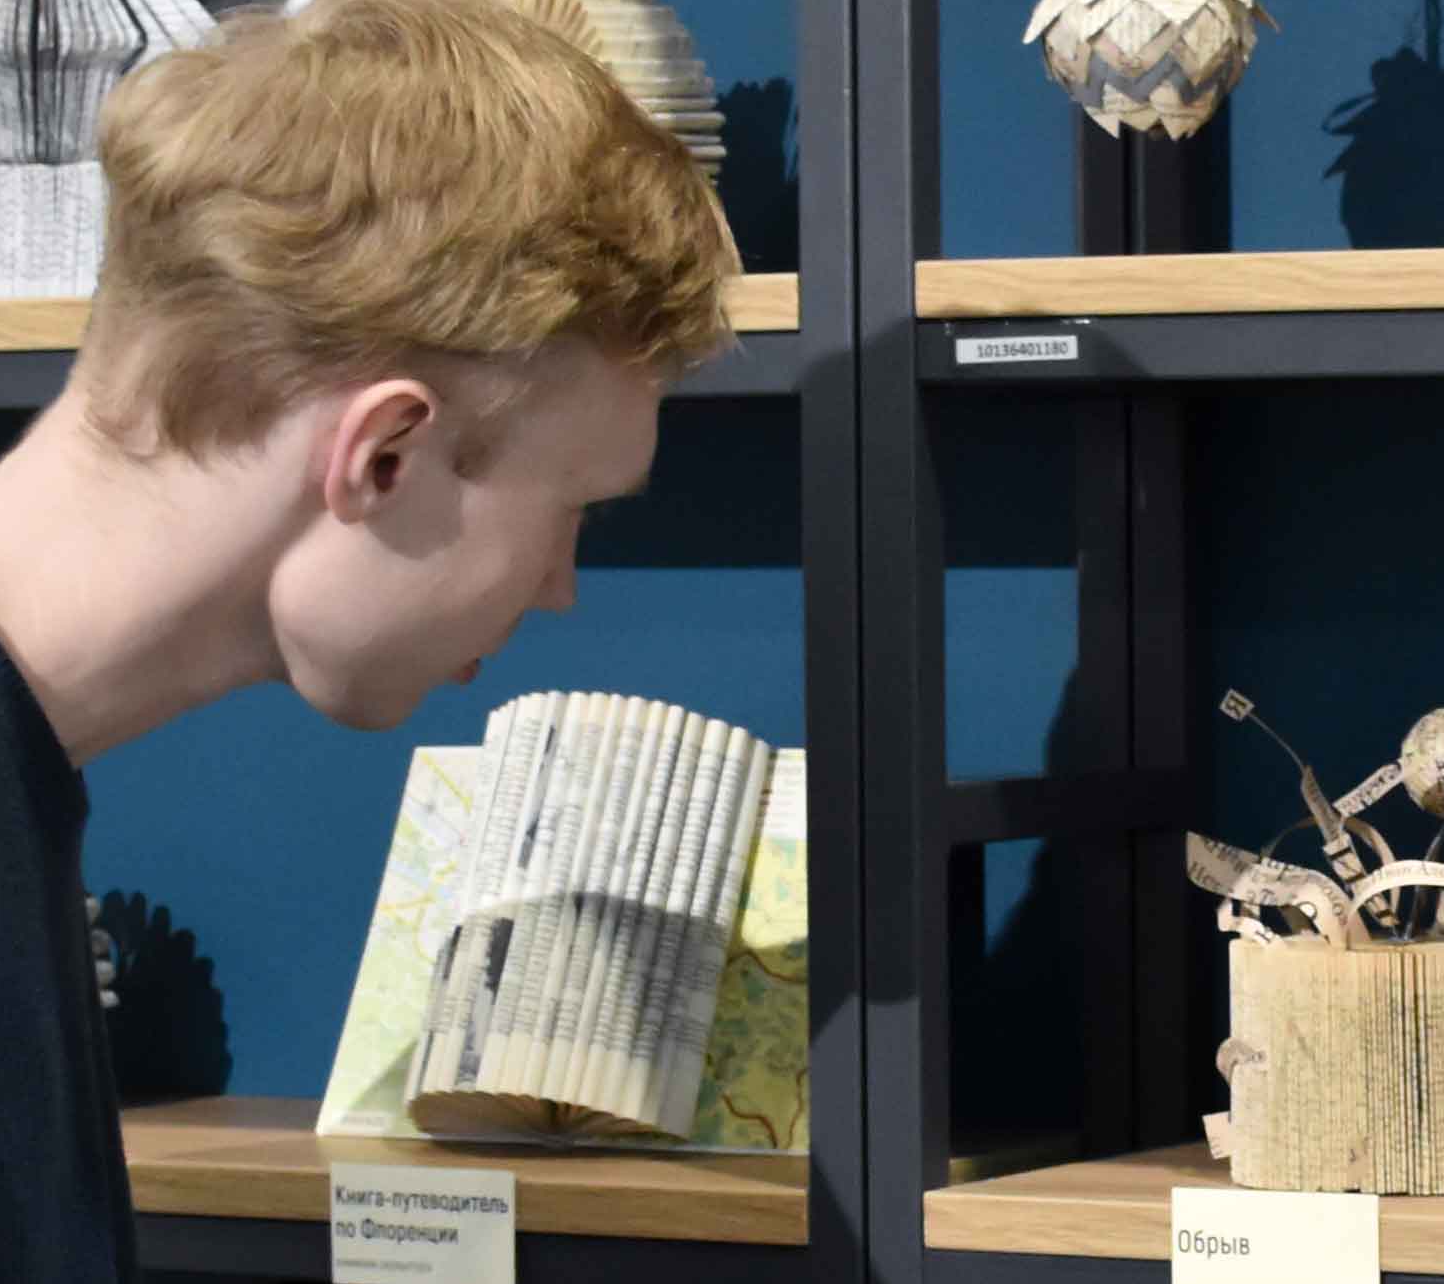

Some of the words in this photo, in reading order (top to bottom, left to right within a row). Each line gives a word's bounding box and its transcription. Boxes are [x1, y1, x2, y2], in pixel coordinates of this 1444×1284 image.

[334, 1185, 510, 1214] Книга-путеводитель
[335, 1220, 355, 1239] по
[360, 1219, 460, 1246] Флоренции
[1177, 1229, 1252, 1260] Обрыв
